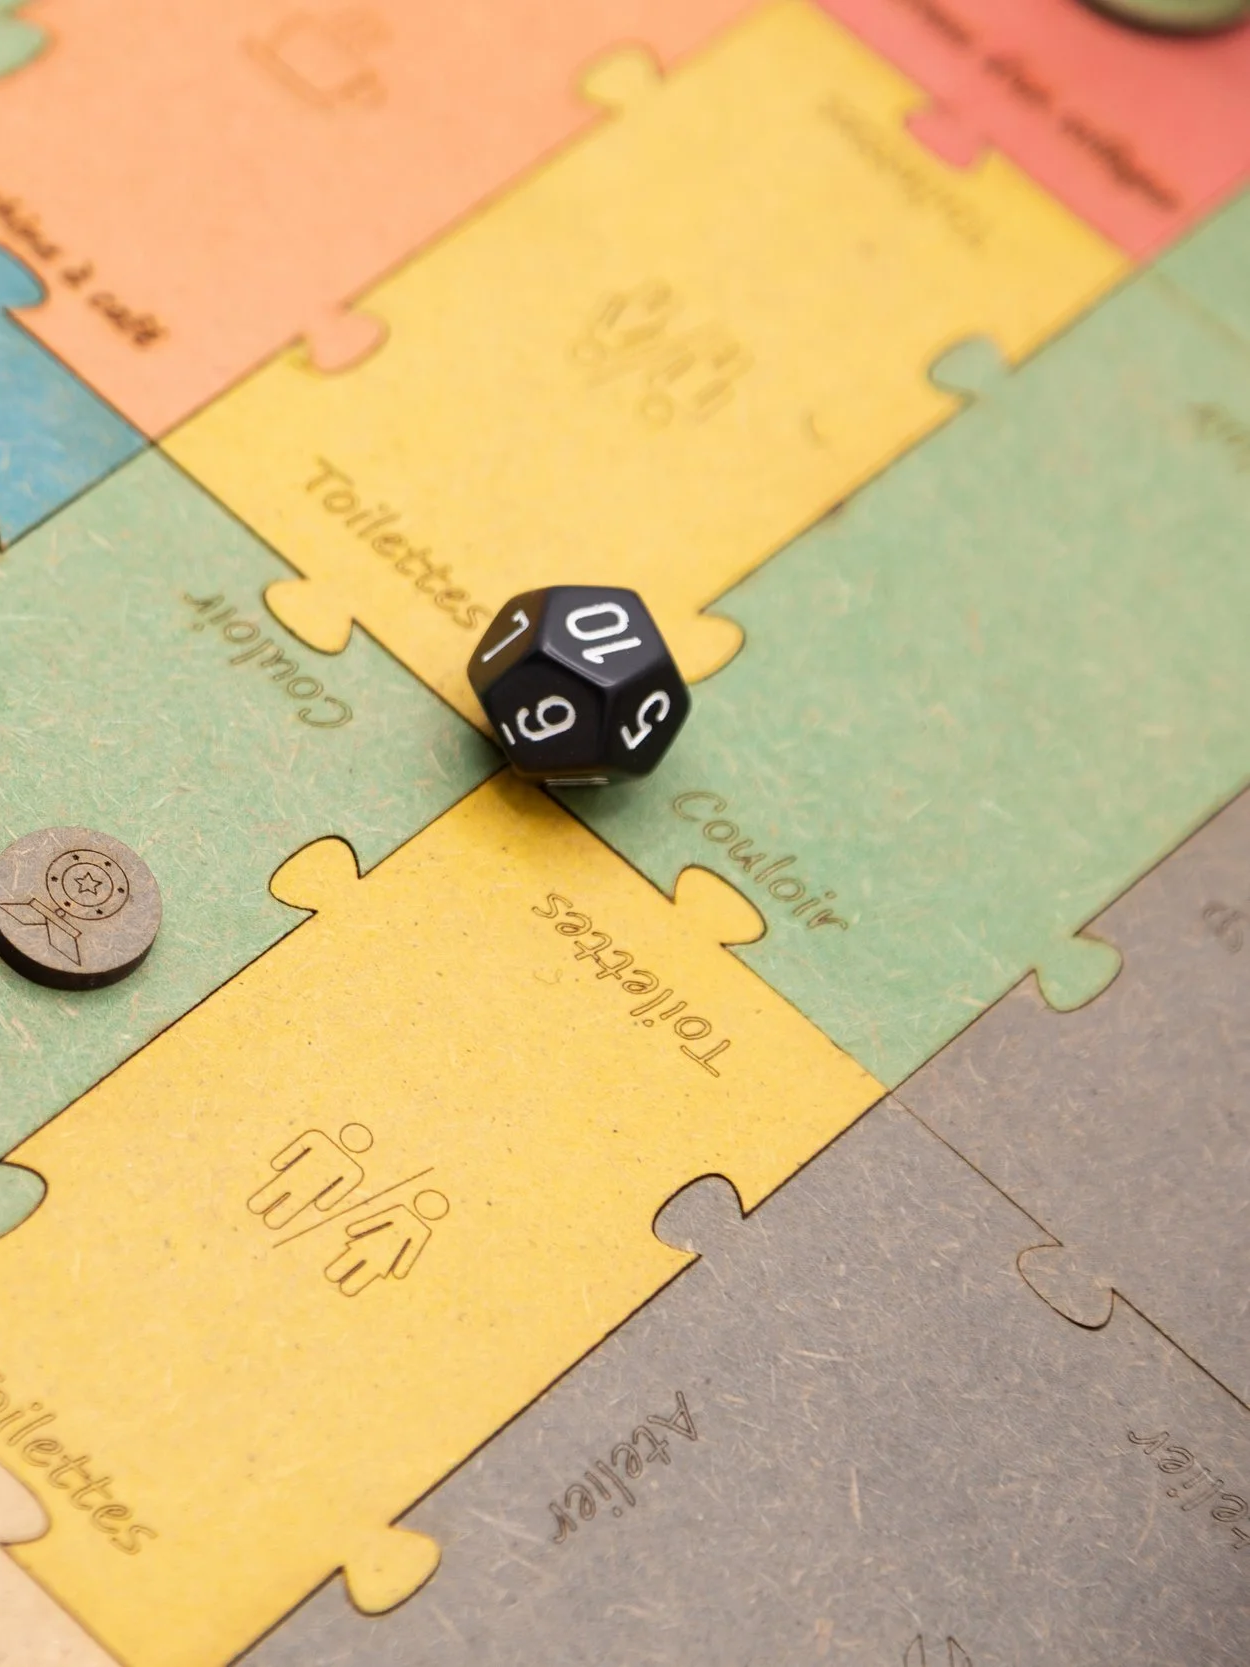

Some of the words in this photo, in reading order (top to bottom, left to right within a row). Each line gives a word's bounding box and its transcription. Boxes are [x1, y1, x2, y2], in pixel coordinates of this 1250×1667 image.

[304, 453, 495, 630] Toilettes
[182, 592, 354, 728] Couloir
[565, 601, 643, 664] 10
[620, 690, 671, 751] 5
[672, 790, 849, 931] Couloir
[531, 892, 732, 1078] Toilettes
[548, 1389, 699, 1545] Atelier
